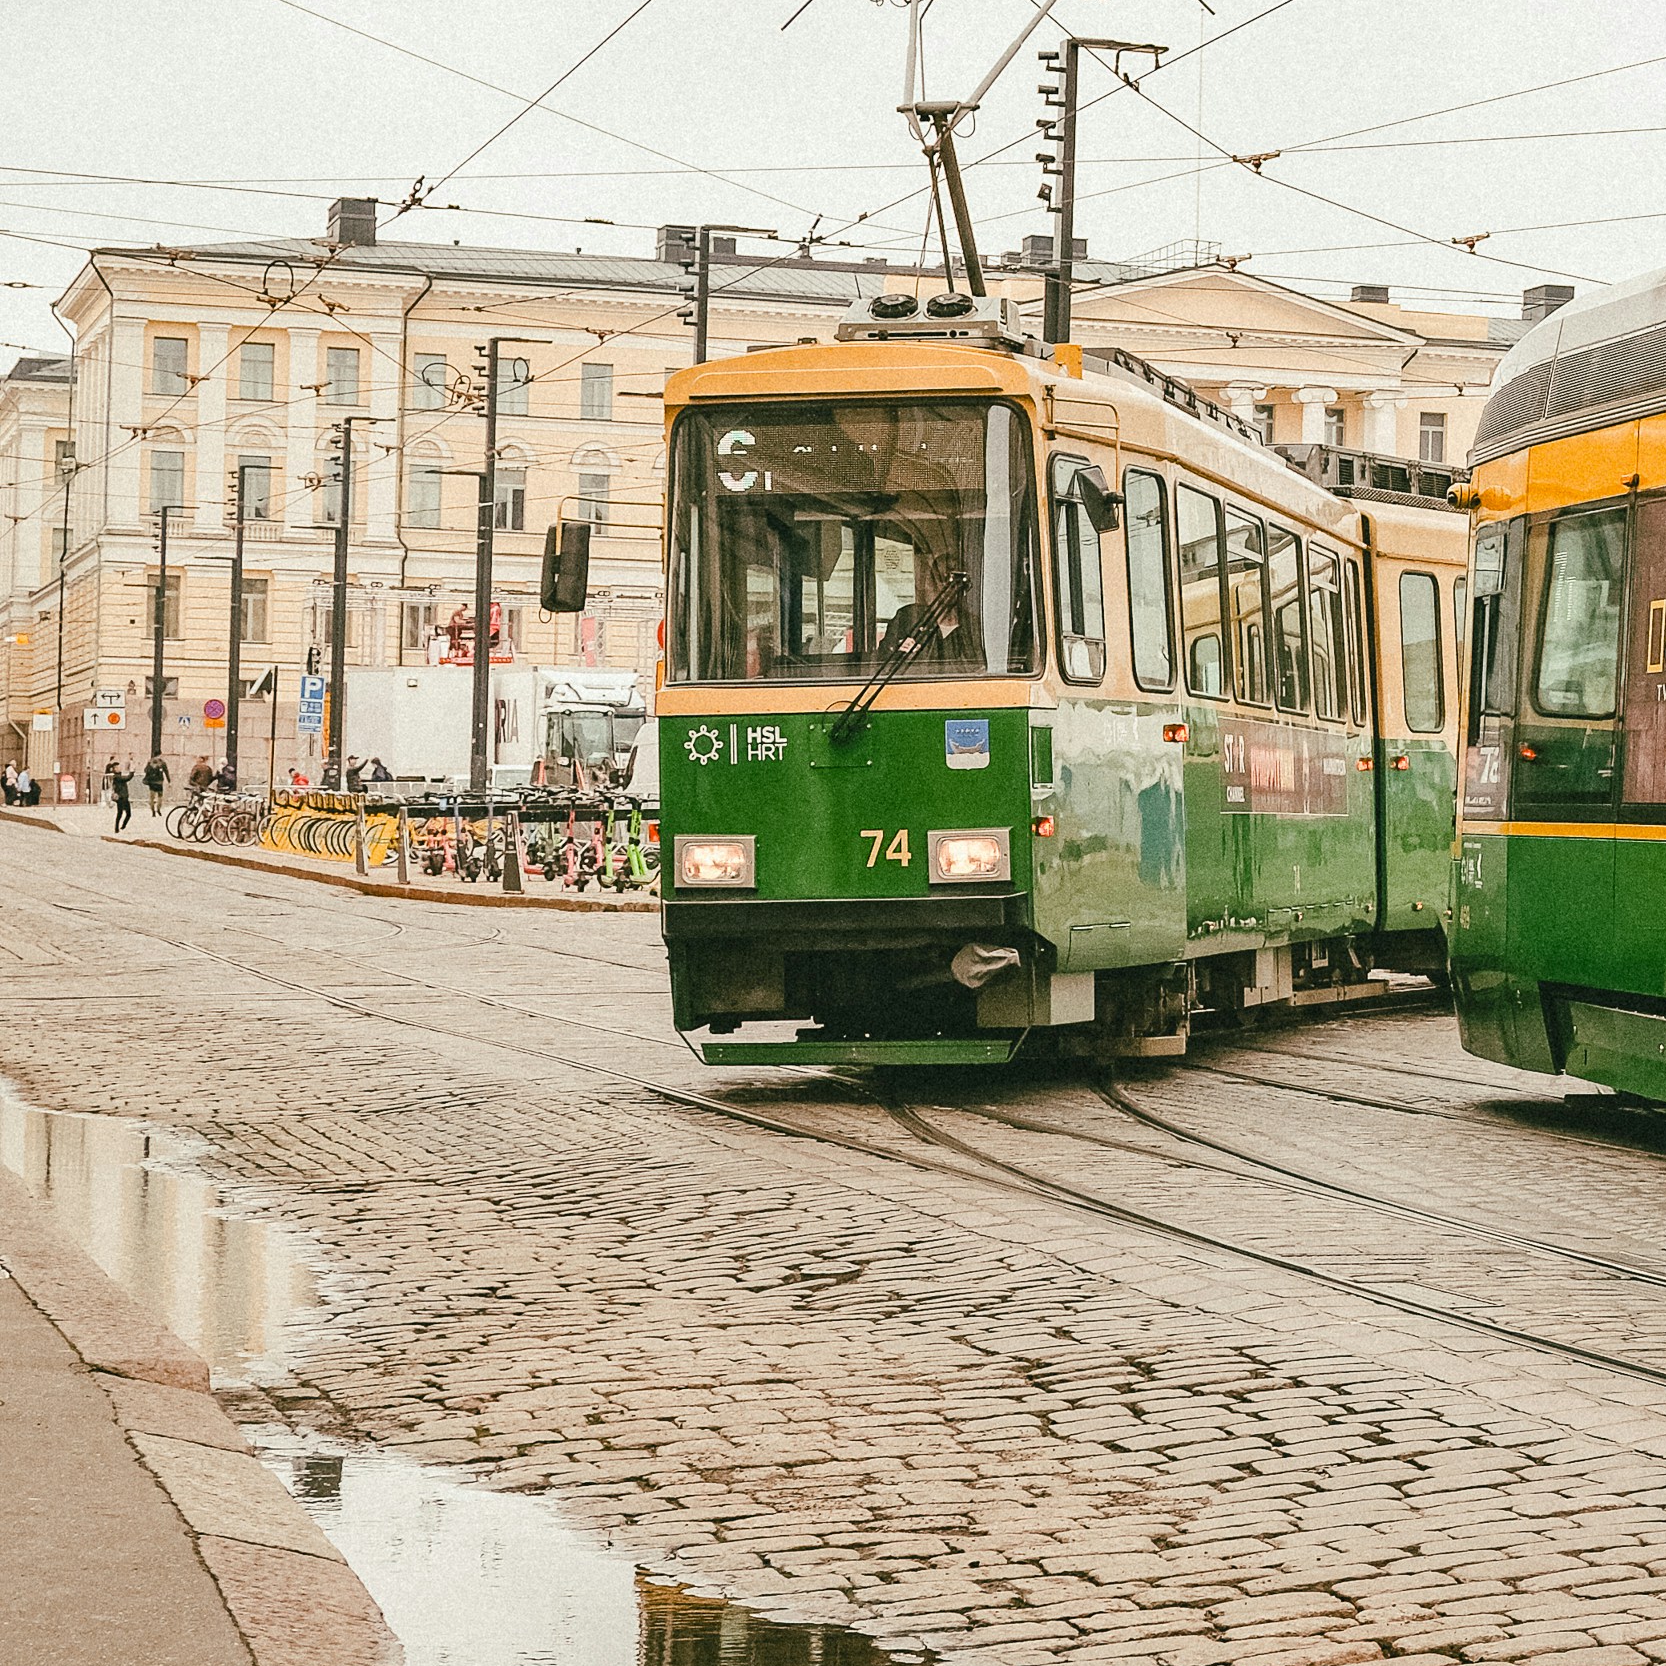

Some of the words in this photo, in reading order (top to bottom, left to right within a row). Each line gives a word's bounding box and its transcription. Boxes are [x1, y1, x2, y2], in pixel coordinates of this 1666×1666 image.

[747, 725, 788, 744] HSL
[747, 742, 788, 762] HRT
[860, 828, 912, 868] 74
